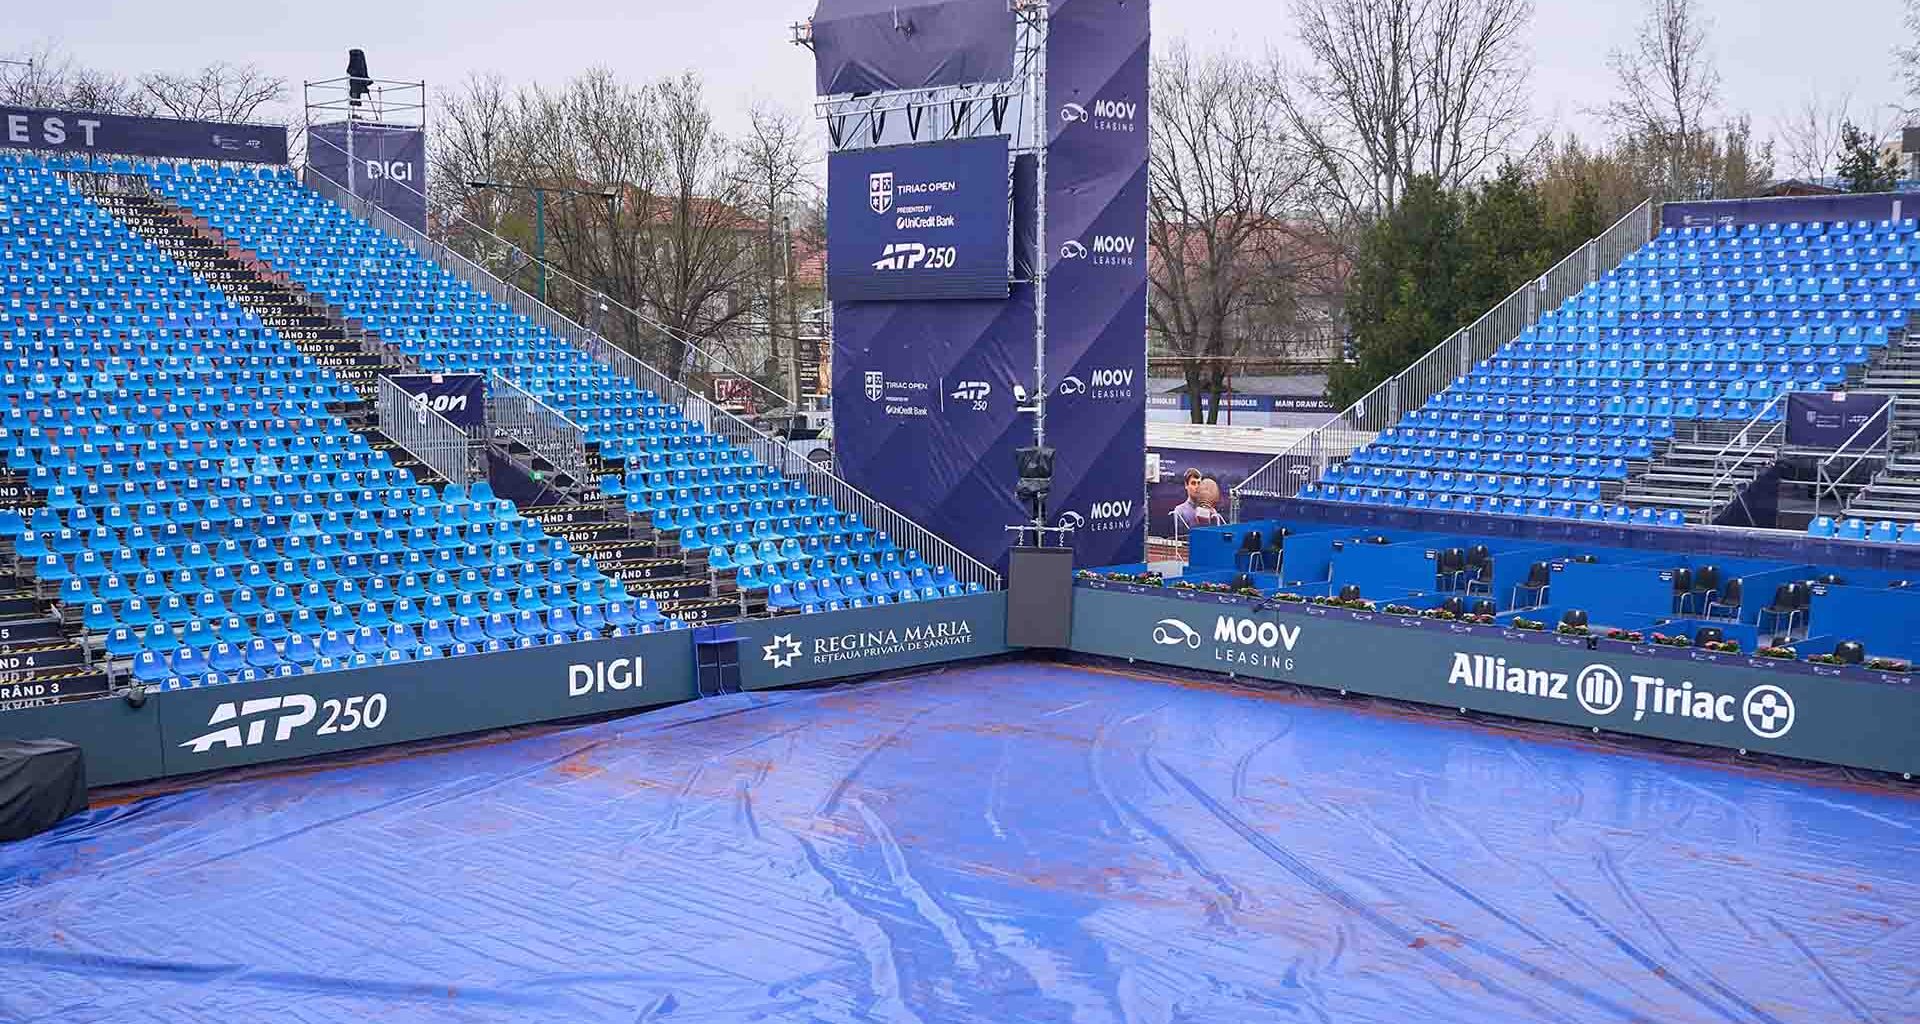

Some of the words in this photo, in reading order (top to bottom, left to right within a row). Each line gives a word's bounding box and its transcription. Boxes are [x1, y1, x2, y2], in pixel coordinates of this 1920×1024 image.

[1094, 100, 1136, 119] MOOV
[7, 114, 101, 147] EST
[1094, 121, 1135, 132] LEASING
[366, 160, 412, 181] DIGI
[897, 183, 927, 196] TIRIAC
[928, 181, 955, 192] OPEN
[905, 215, 935, 228] UniCredit
[936, 215, 954, 227] Bank
[1093, 236, 1135, 253] MOOV
[872, 242, 926, 270] ATP
[924, 247, 956, 269] 250
[1093, 255, 1133, 265] LEASING
[1091, 369, 1134, 387] MOOV
[950, 381, 991, 400] ATP
[1091, 390, 1132, 399] LEASING
[972, 400, 988, 411] 250
[1275, 399, 1294, 407] MAIN
[1296, 400, 1317, 408] DRAW
[0, 487, 18, 496] ND
[18, 507, 36, 516] ND
[567, 513, 573, 521] 8
[1090, 500, 1132, 519] MOOV
[1091, 519, 1131, 532] LEASING
[592, 532, 598, 540] 7
[673, 590, 679, 598] 4
[1, 628, 9, 639] 5
[814, 629, 897, 654] REGINA
[904, 620, 971, 642] MARIA
[1214, 615, 1301, 651] MOOV
[908, 640, 921, 651] DE
[0, 657, 20, 669] ND
[26, 656, 35, 667] 4
[1215, 648, 1294, 670] LEASING
[568, 656, 644, 696] DIGI
[1448, 652, 1569, 700] Allianz
[1, 684, 45, 698] RÂND
[51, 683, 60, 693] 3
[1630, 675, 1736, 722] Țiriac
[178, 693, 318, 752] ATP
[316, 692, 388, 736] 250
